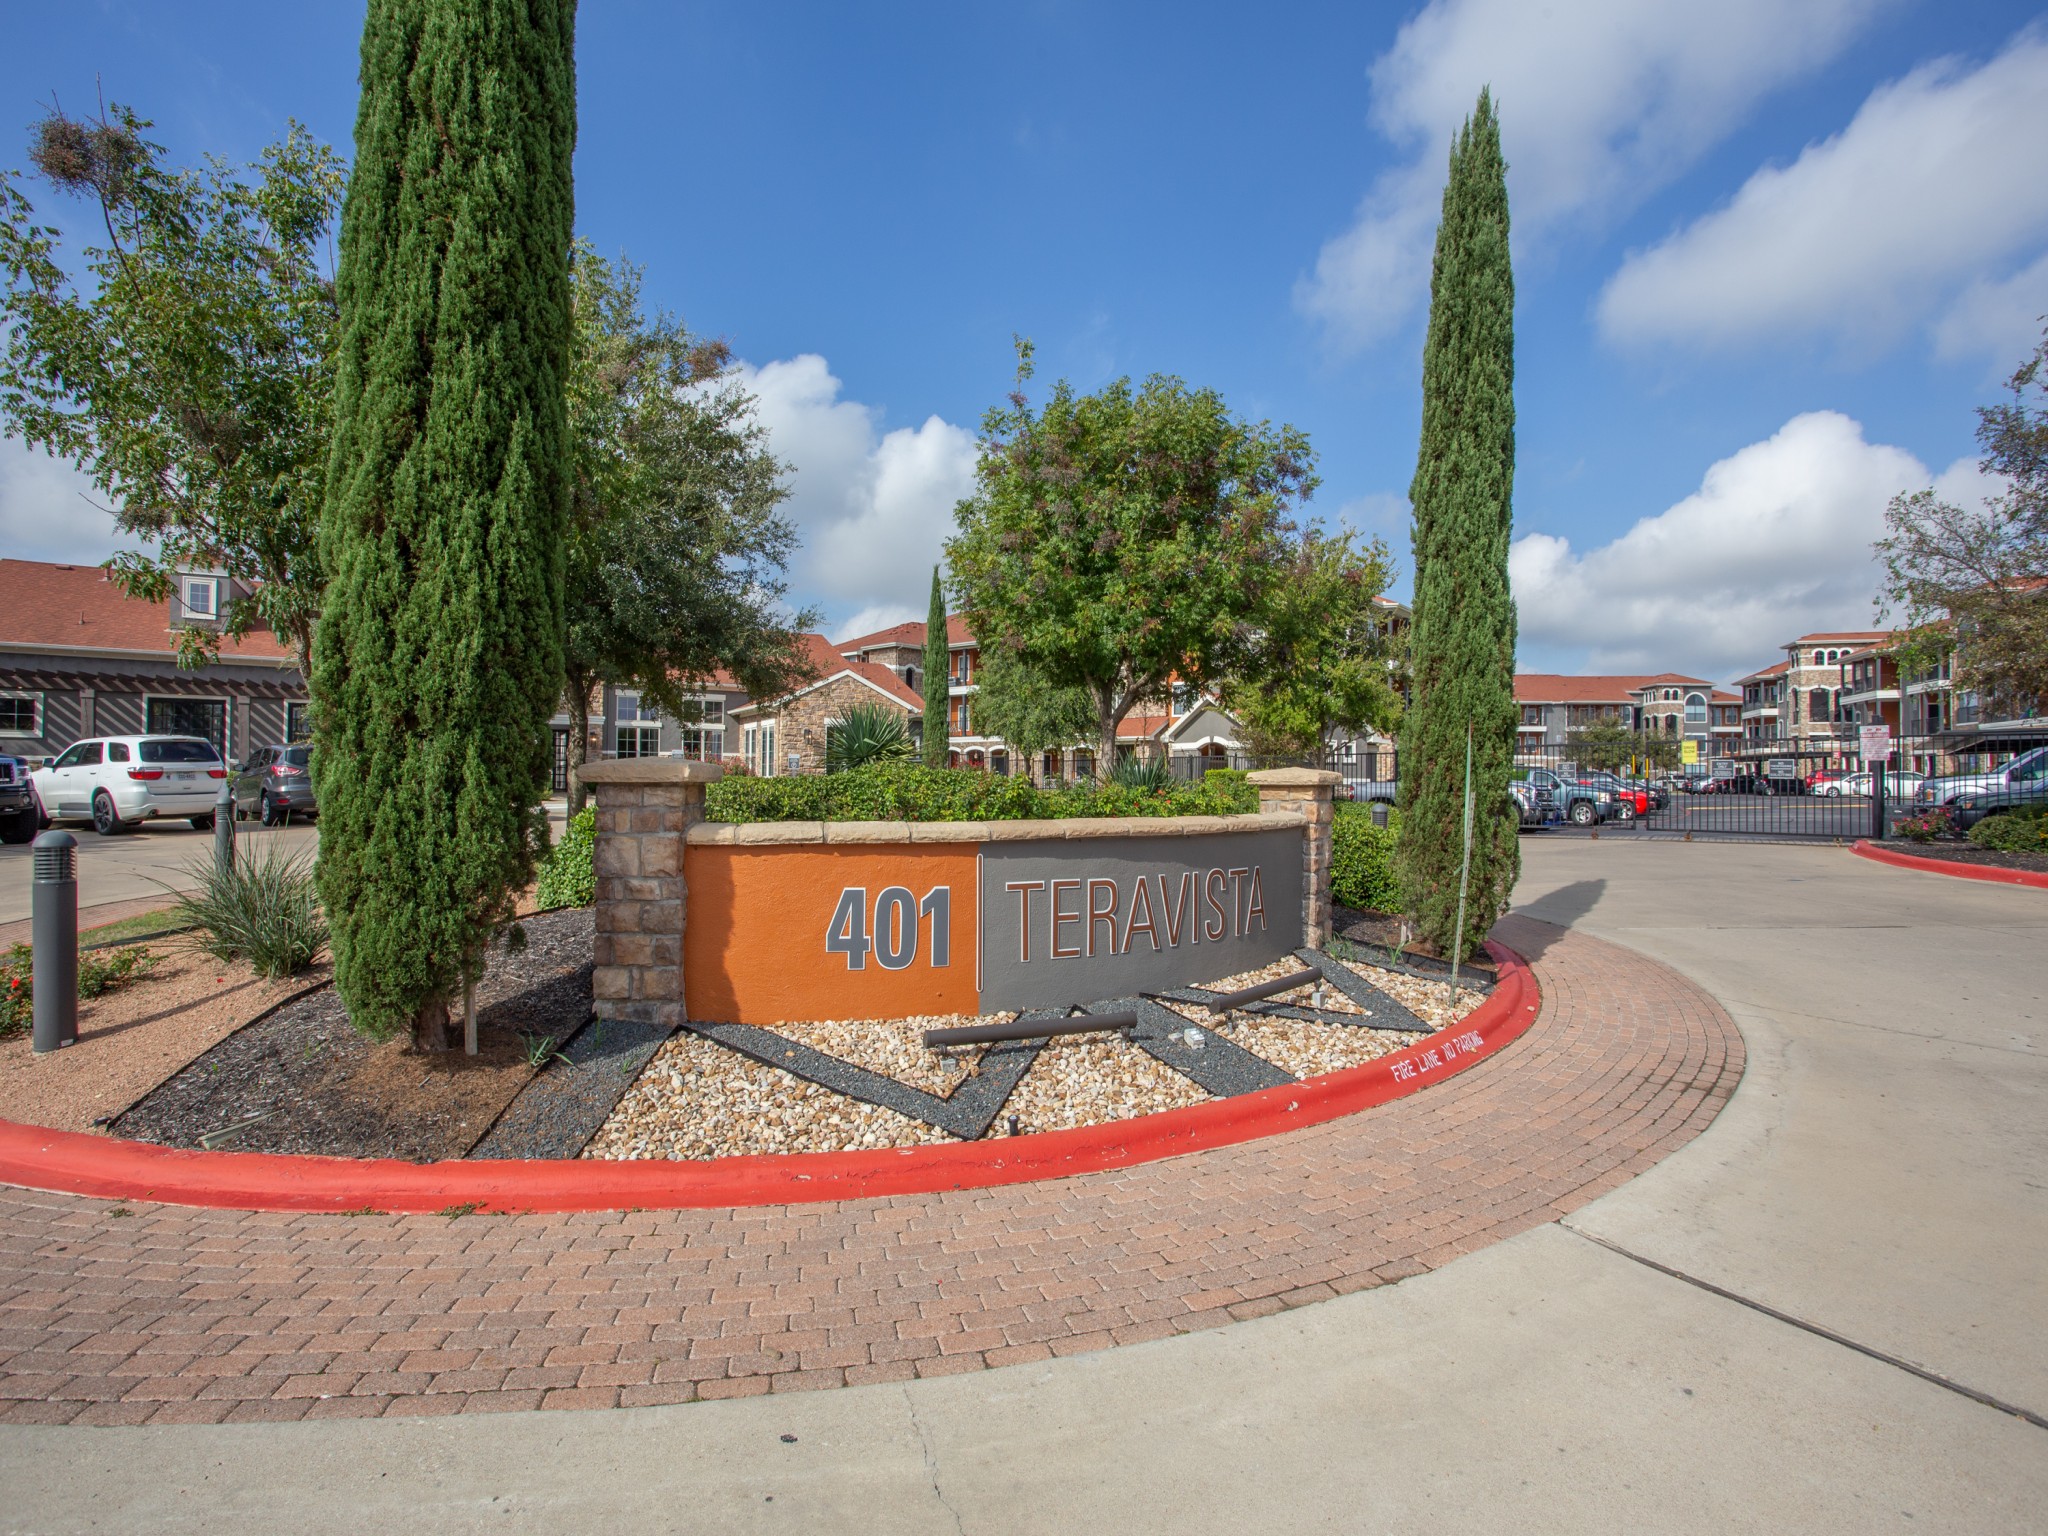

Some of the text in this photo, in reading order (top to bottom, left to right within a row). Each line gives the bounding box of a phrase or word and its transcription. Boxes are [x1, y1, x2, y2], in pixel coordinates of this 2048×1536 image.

[825, 864, 1268, 971] 401 TERAVISTA
[1390, 1030, 1484, 1083] FIRE LANE NO PARKING
